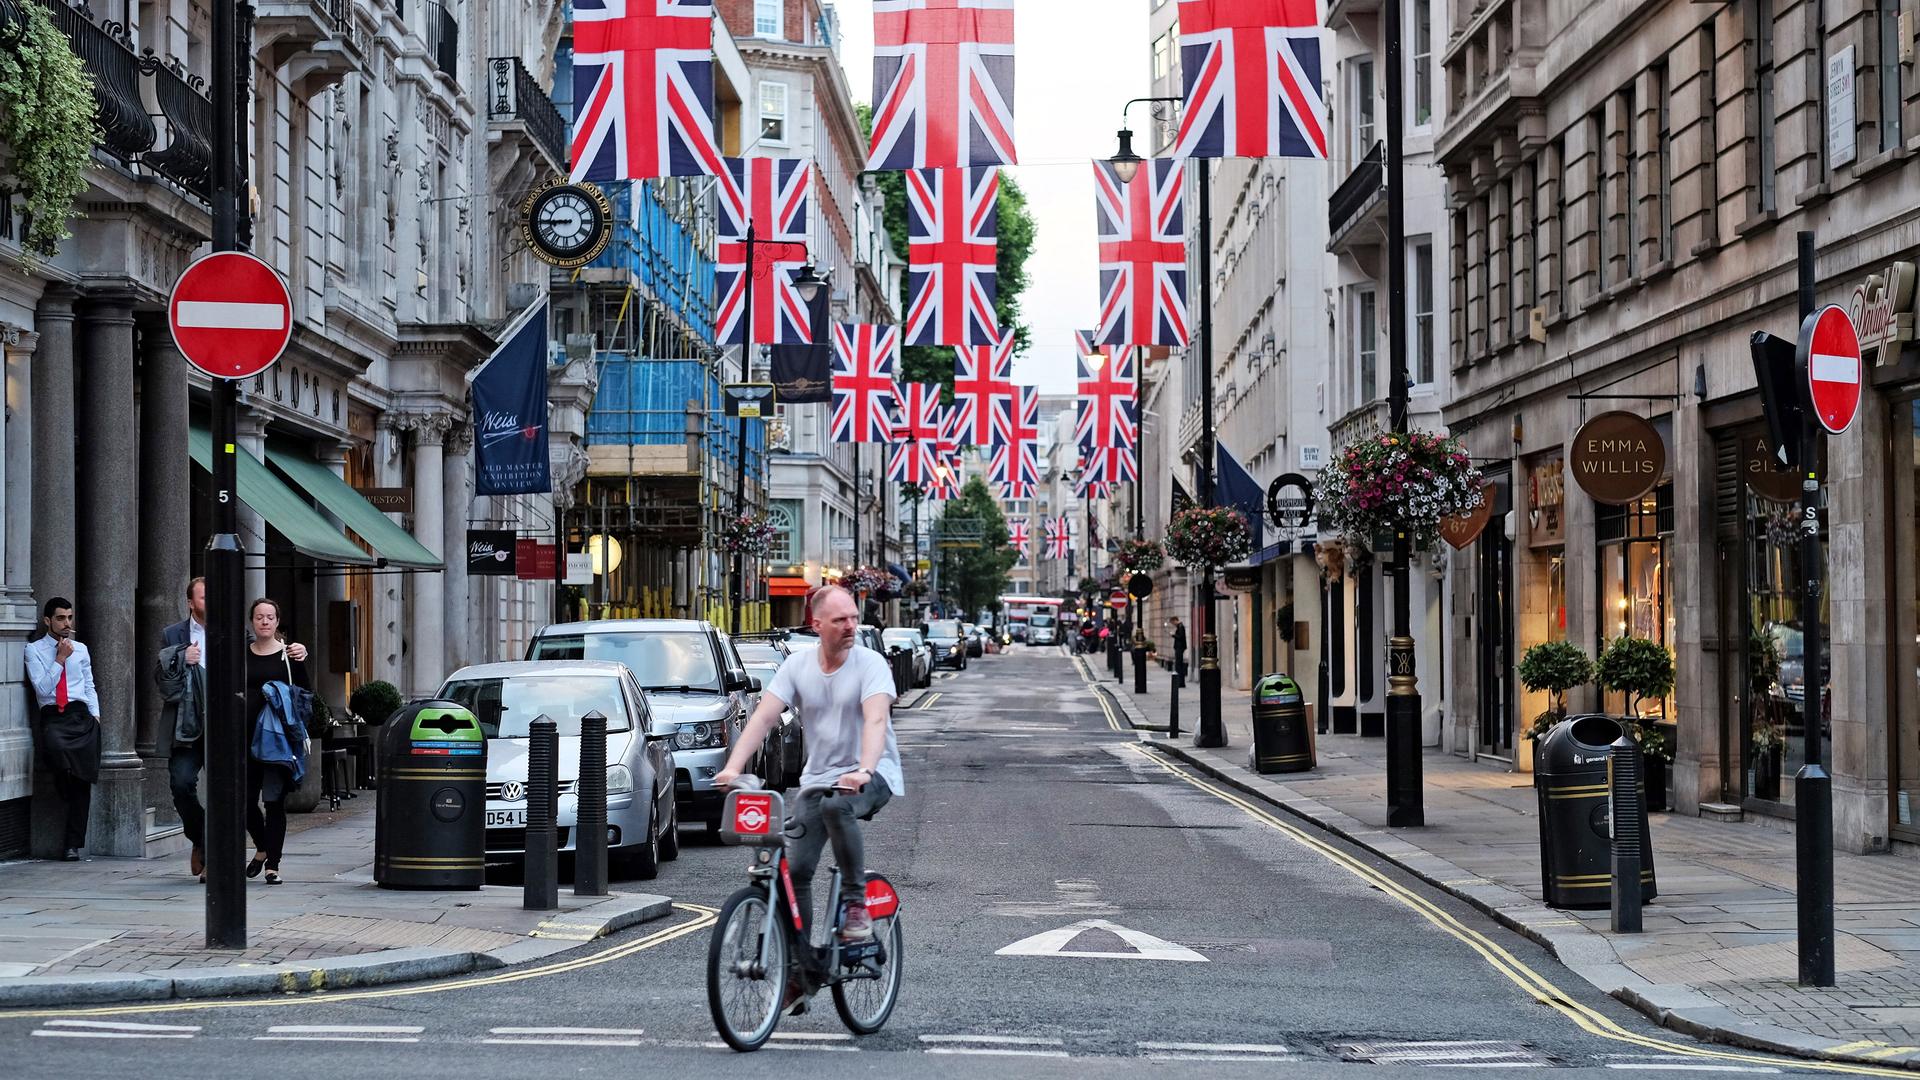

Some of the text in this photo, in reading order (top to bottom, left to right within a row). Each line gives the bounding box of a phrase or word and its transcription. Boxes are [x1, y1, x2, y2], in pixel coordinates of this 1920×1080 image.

[523, 188, 543, 215] SIMON
[597, 196, 610, 214] LTD
[532, 245, 559, 265] MODERN
[559, 257, 587, 266] MASTER
[480, 410, 519, 432] Weiss
[1303, 447, 1320, 455] BURY
[1588, 439, 1647, 453] EMMA
[1304, 454, 1319, 462] STRE
[1582, 460, 1654, 474] WILLIS
[494, 480, 533, 489] ON VIEW
[218, 490, 229, 503] 5
[1450, 521, 1468, 533] 67
[470, 541, 494, 553] Weiss
[1586, 755, 1605, 763] general
[486, 812, 514, 825] D54
